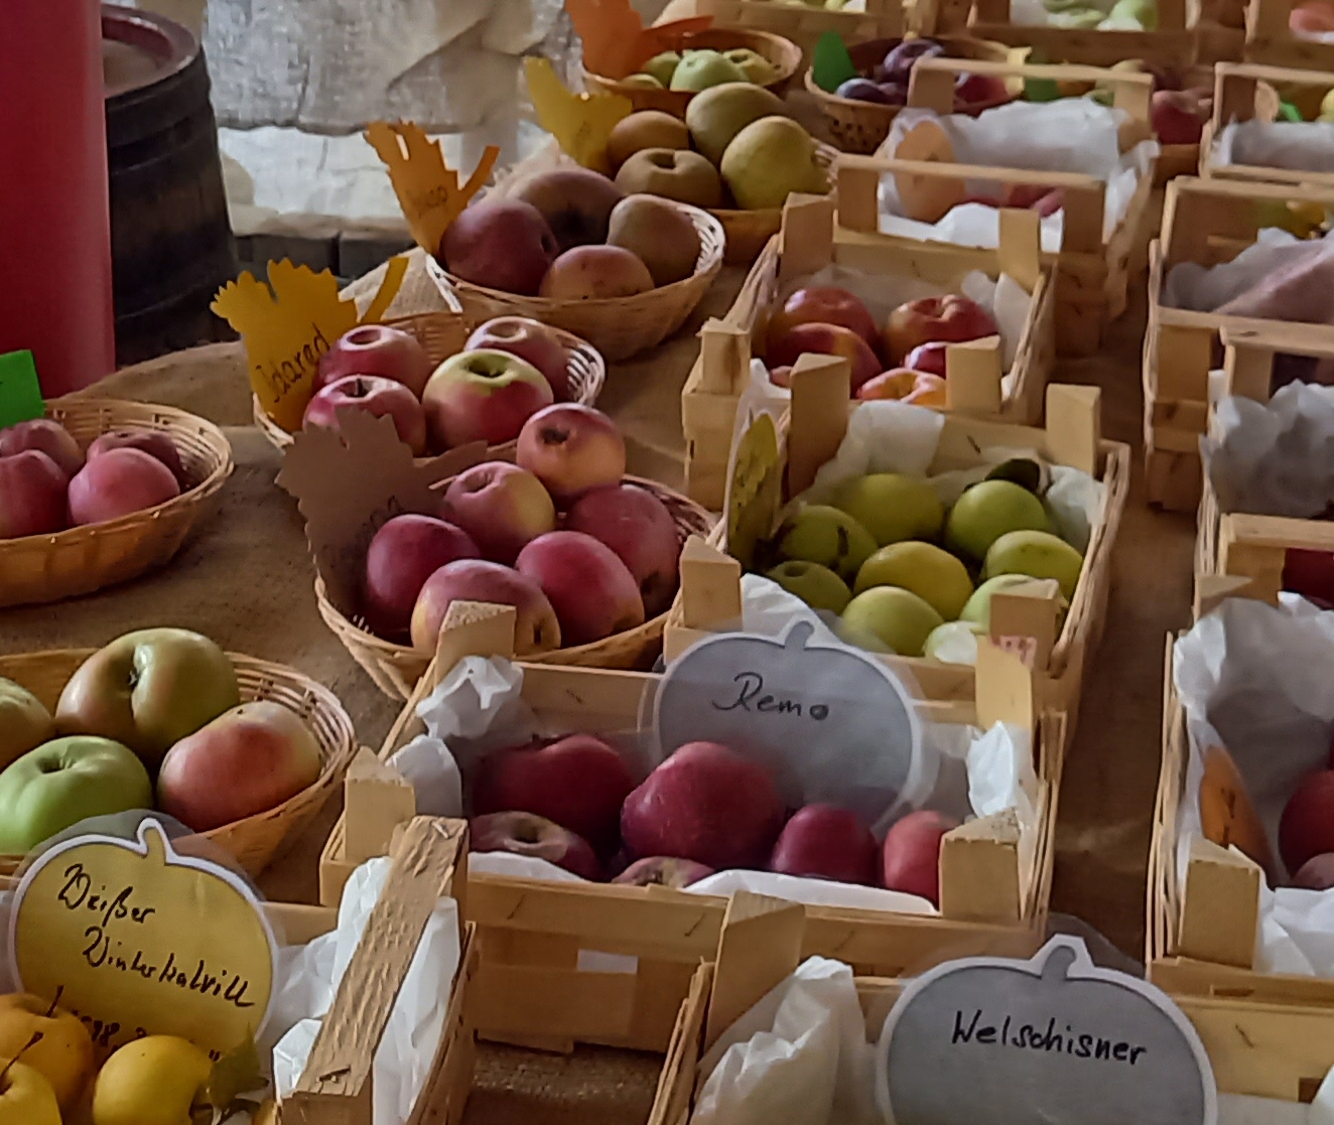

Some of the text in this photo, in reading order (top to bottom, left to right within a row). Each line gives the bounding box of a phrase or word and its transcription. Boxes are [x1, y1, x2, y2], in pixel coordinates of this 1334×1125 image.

[712, 671, 829, 720] Remo
[58, 863, 156, 927] Weißer
[952, 1009, 1147, 1065] Welschisner
